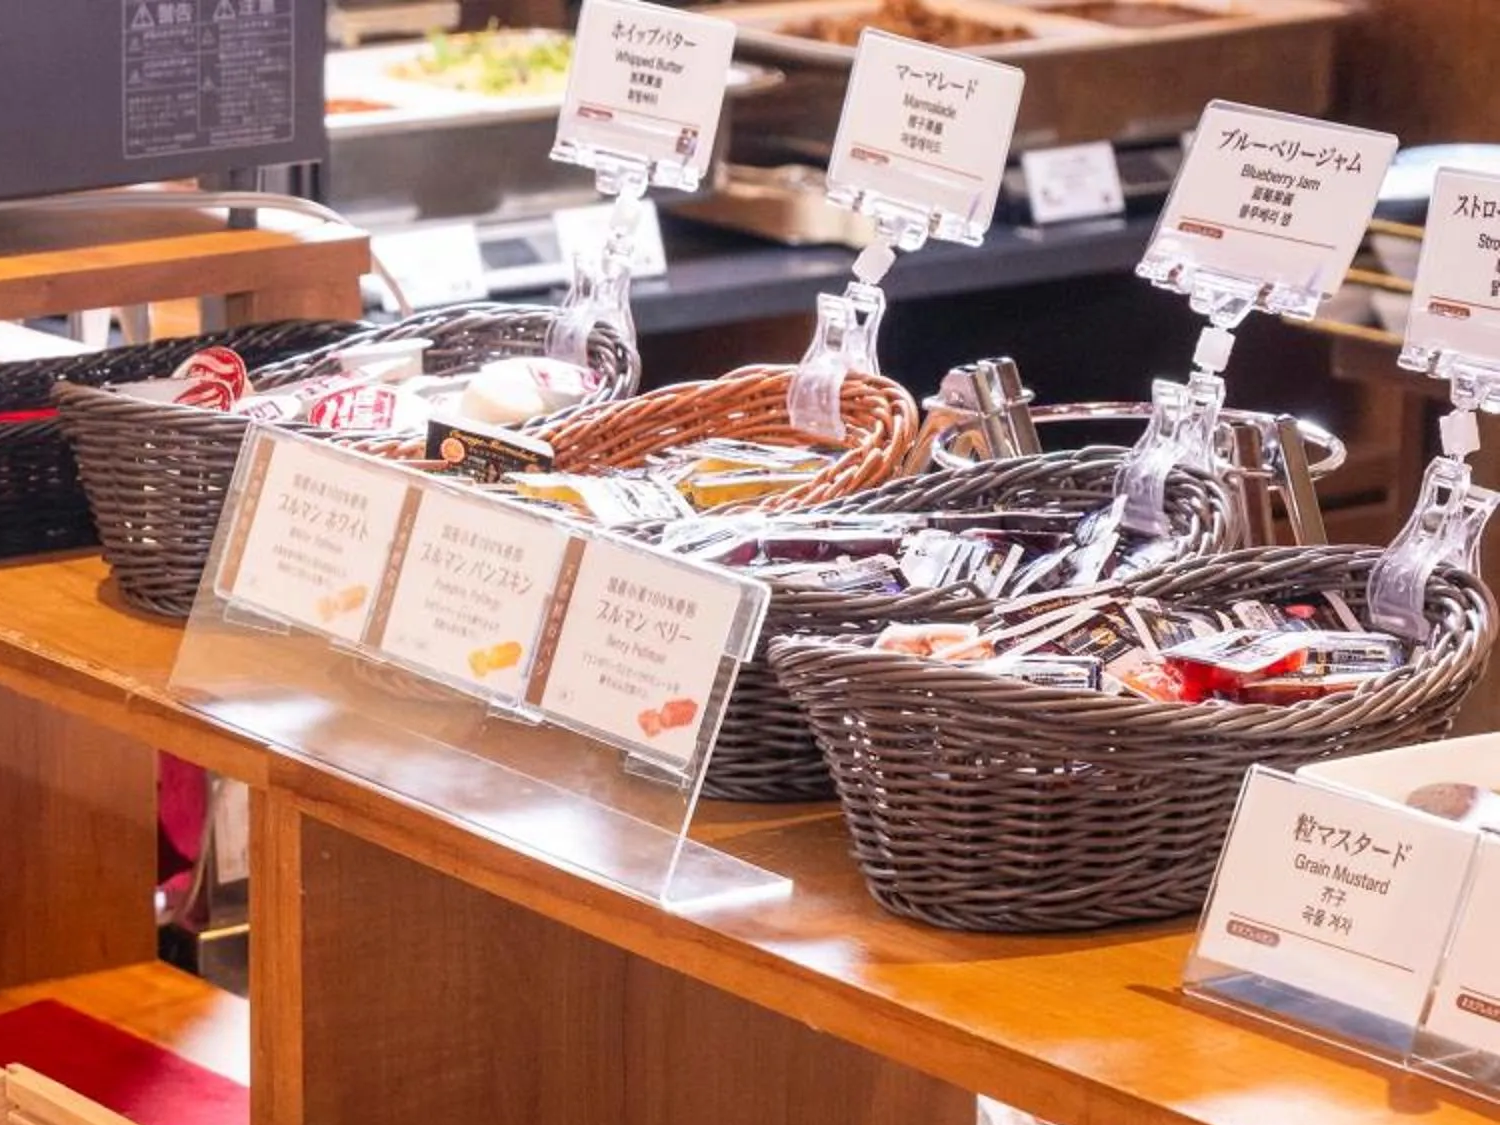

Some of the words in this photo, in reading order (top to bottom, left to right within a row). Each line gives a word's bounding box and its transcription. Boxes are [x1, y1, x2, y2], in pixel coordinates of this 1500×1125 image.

[896, 64, 979, 100] マーマレード
[1219, 128, 1361, 173] ブルーベリージャム
[1241, 164, 1296, 188] Blueberry
[1296, 175, 1320, 190] Jam
[1453, 194, 1500, 218] ストロ
[1294, 813, 1413, 868] 粒マスタード
[1294, 853, 1331, 877] Grain
[1332, 863, 1391, 895] Mustard
